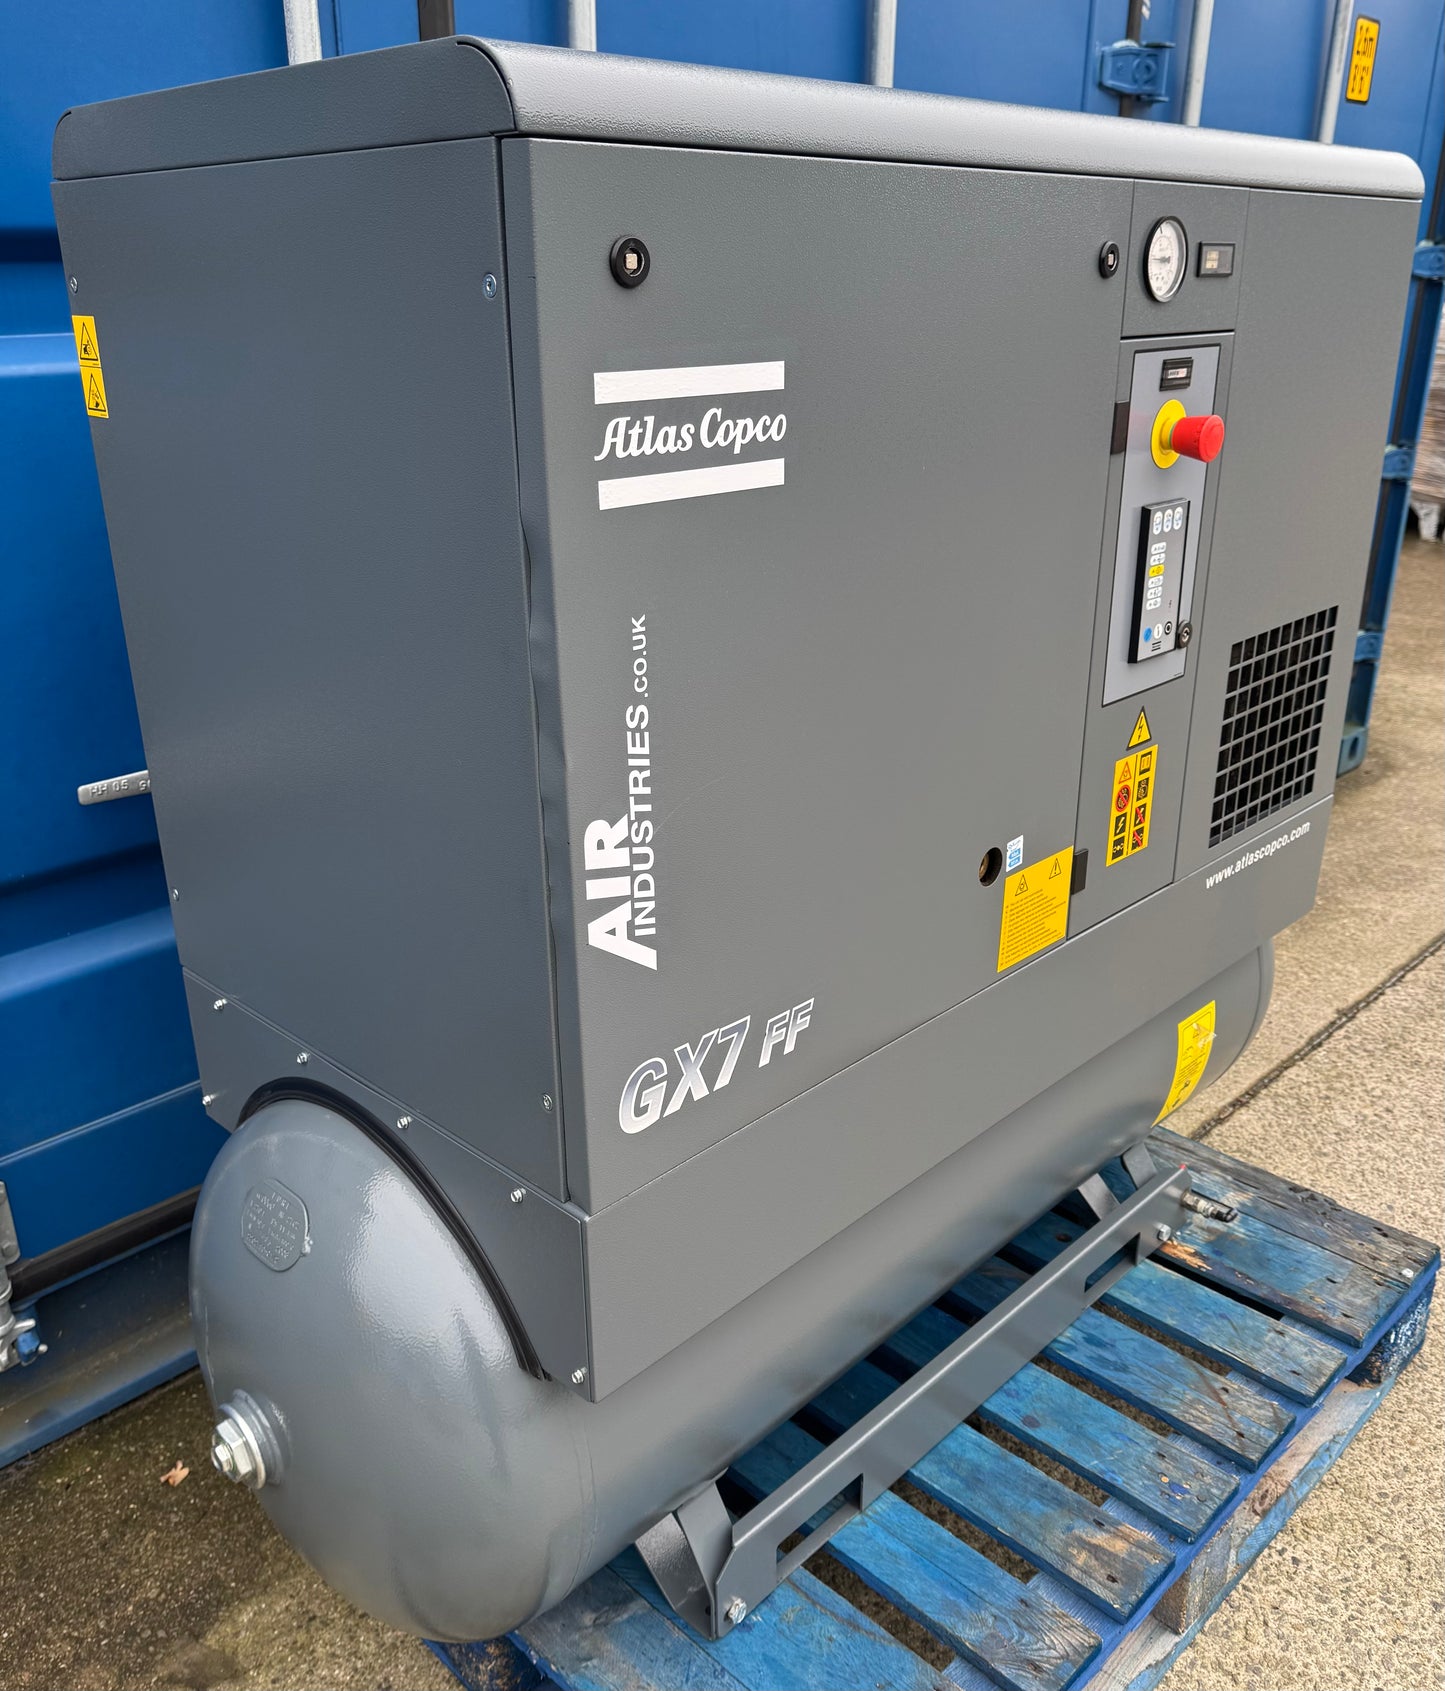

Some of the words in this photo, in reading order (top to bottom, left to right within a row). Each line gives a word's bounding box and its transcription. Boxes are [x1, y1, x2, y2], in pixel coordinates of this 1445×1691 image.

[594, 416, 695, 462] Atlas
[699, 407, 787, 455] Copco
[625, 704, 657, 937] INDUSTRIES
[1205, 822, 1311, 889] www.atlascopco.com
[584, 813, 658, 971] AIR
[618, 1014, 751, 1135] GX7
[758, 997, 815, 1069] FF
